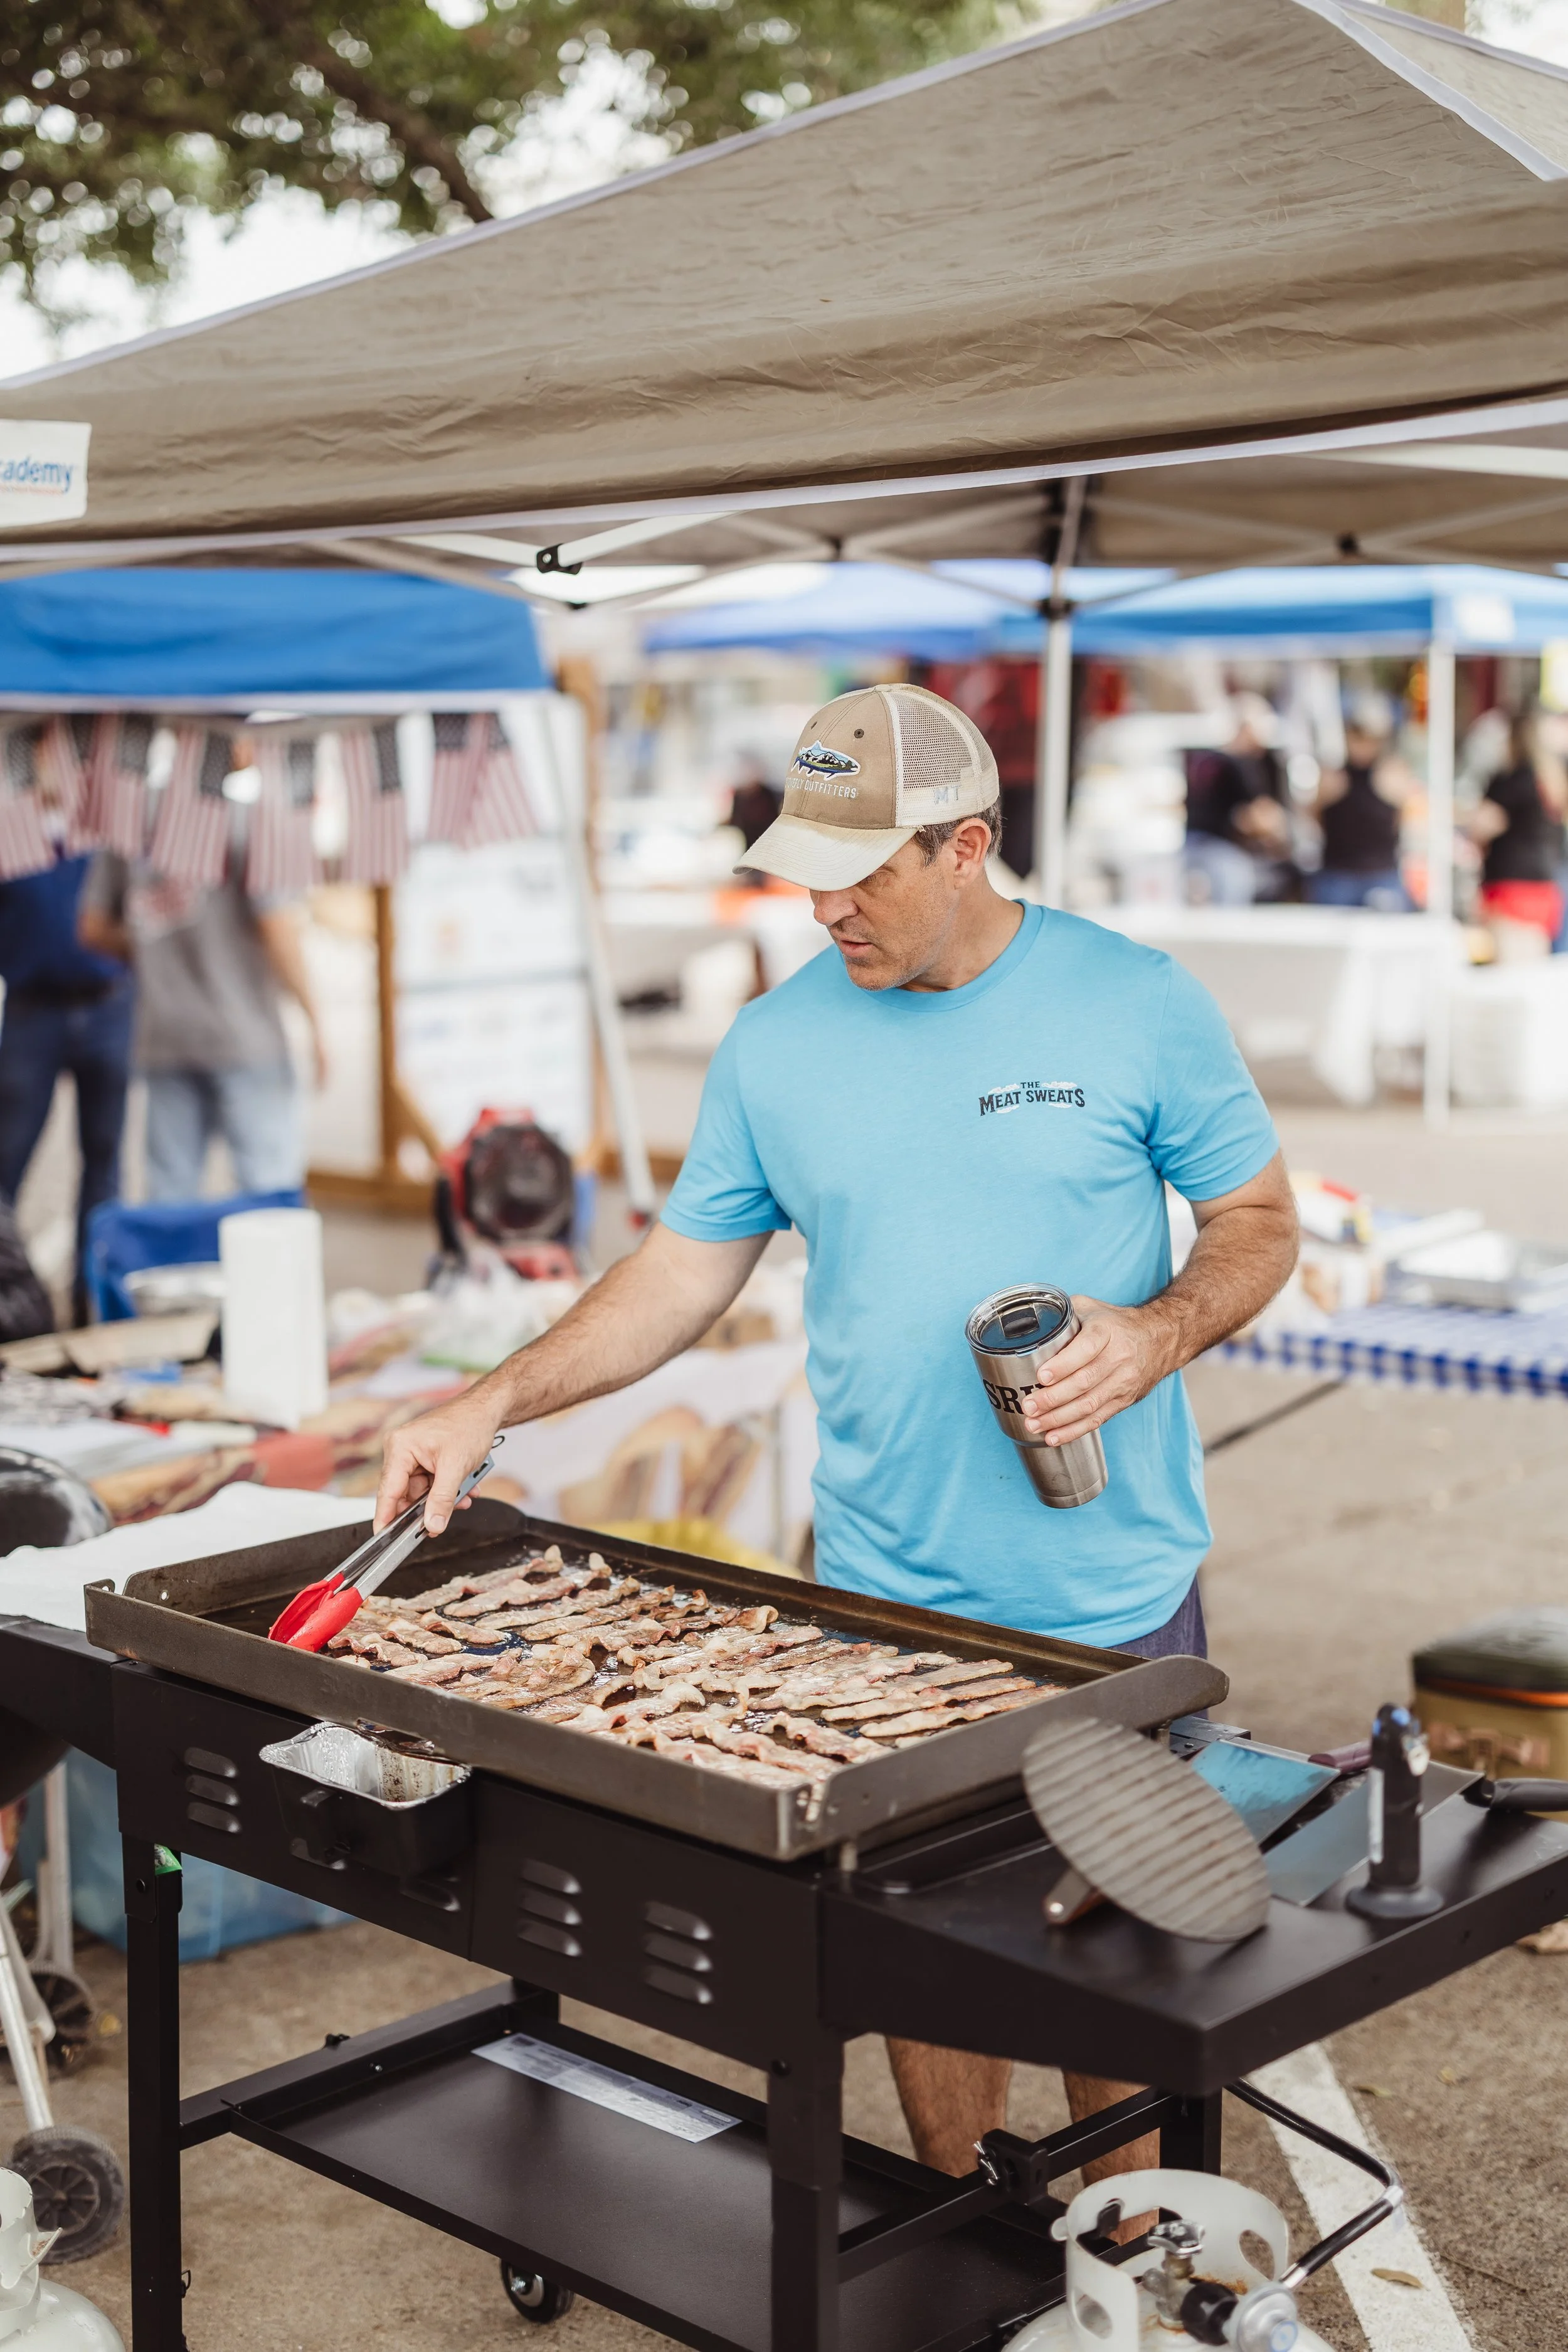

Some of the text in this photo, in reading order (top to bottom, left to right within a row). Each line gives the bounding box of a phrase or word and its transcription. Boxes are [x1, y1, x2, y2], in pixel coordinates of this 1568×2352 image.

[0, 455, 73, 494] ademy
[804, 779, 857, 799] OUTFITTERS
[978, 1088, 1085, 1116] MEAT SWEATS
